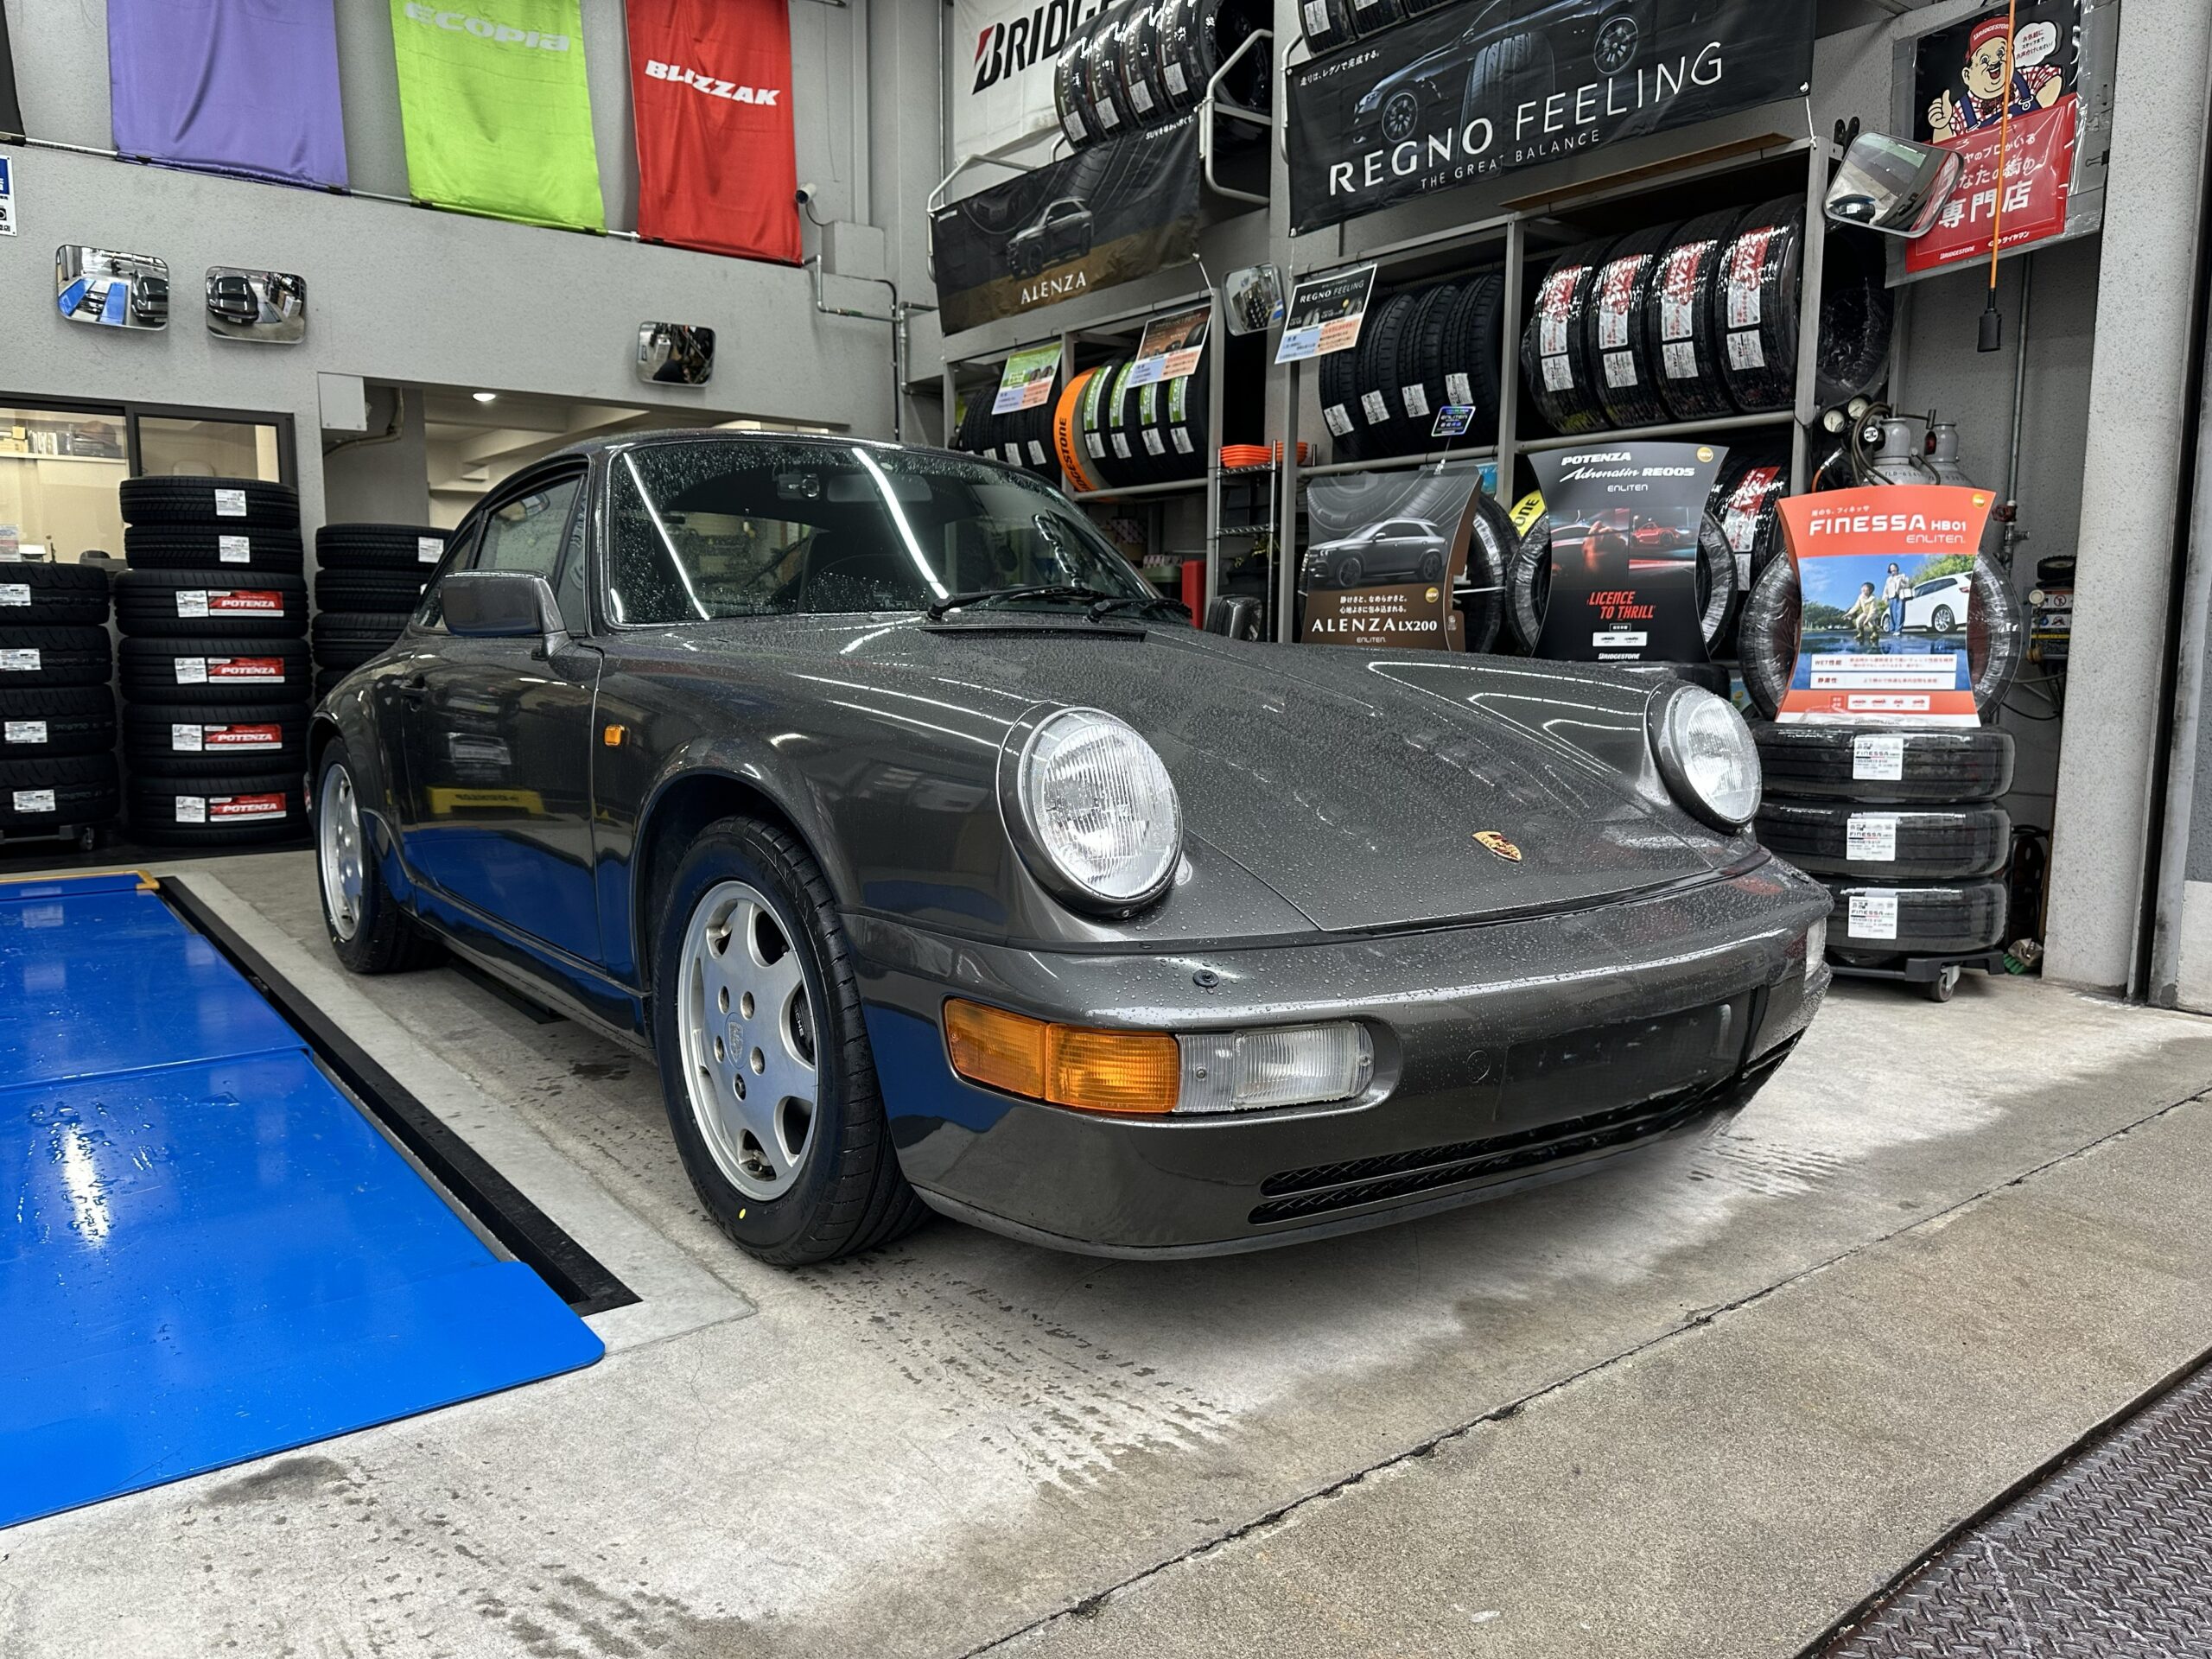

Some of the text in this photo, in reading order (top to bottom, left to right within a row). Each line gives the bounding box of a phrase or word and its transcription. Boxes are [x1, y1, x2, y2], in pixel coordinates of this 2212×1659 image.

[972, 0, 1116, 95] BRIDG
[645, 60, 780, 105] BLIZZAK
[1329, 41, 1723, 196] REGNO FEELING
[1421, 174, 1446, 190] THE
[1516, 129, 1601, 162] BALANCE
[1964, 133, 2036, 164] ヤのプロがいる
[1953, 156, 2036, 192] なたの街の
[1938, 180, 2032, 228] 専門店
[1020, 271, 1086, 304] ALENZA
[1300, 289, 1332, 303] REGNO
[1332, 279, 1365, 296] FEELING
[1058, 417, 1092, 492] IDGESTONE
[1561, 452, 1631, 466] POTENZA
[1560, 467, 1640, 483] Adrenalin
[1607, 484, 1649, 493] ENLITEN
[1809, 515, 1967, 536] FINESSA HB01
[1906, 534, 1964, 543] ENLITEN
[1589, 591, 1636, 605] LICENCE
[1312, 617, 1396, 632] ALENZA
[1398, 620, 1437, 632] LX200
[1600, 605, 1655, 620] TO THRILL
[222, 803, 277, 813] POTENZA
